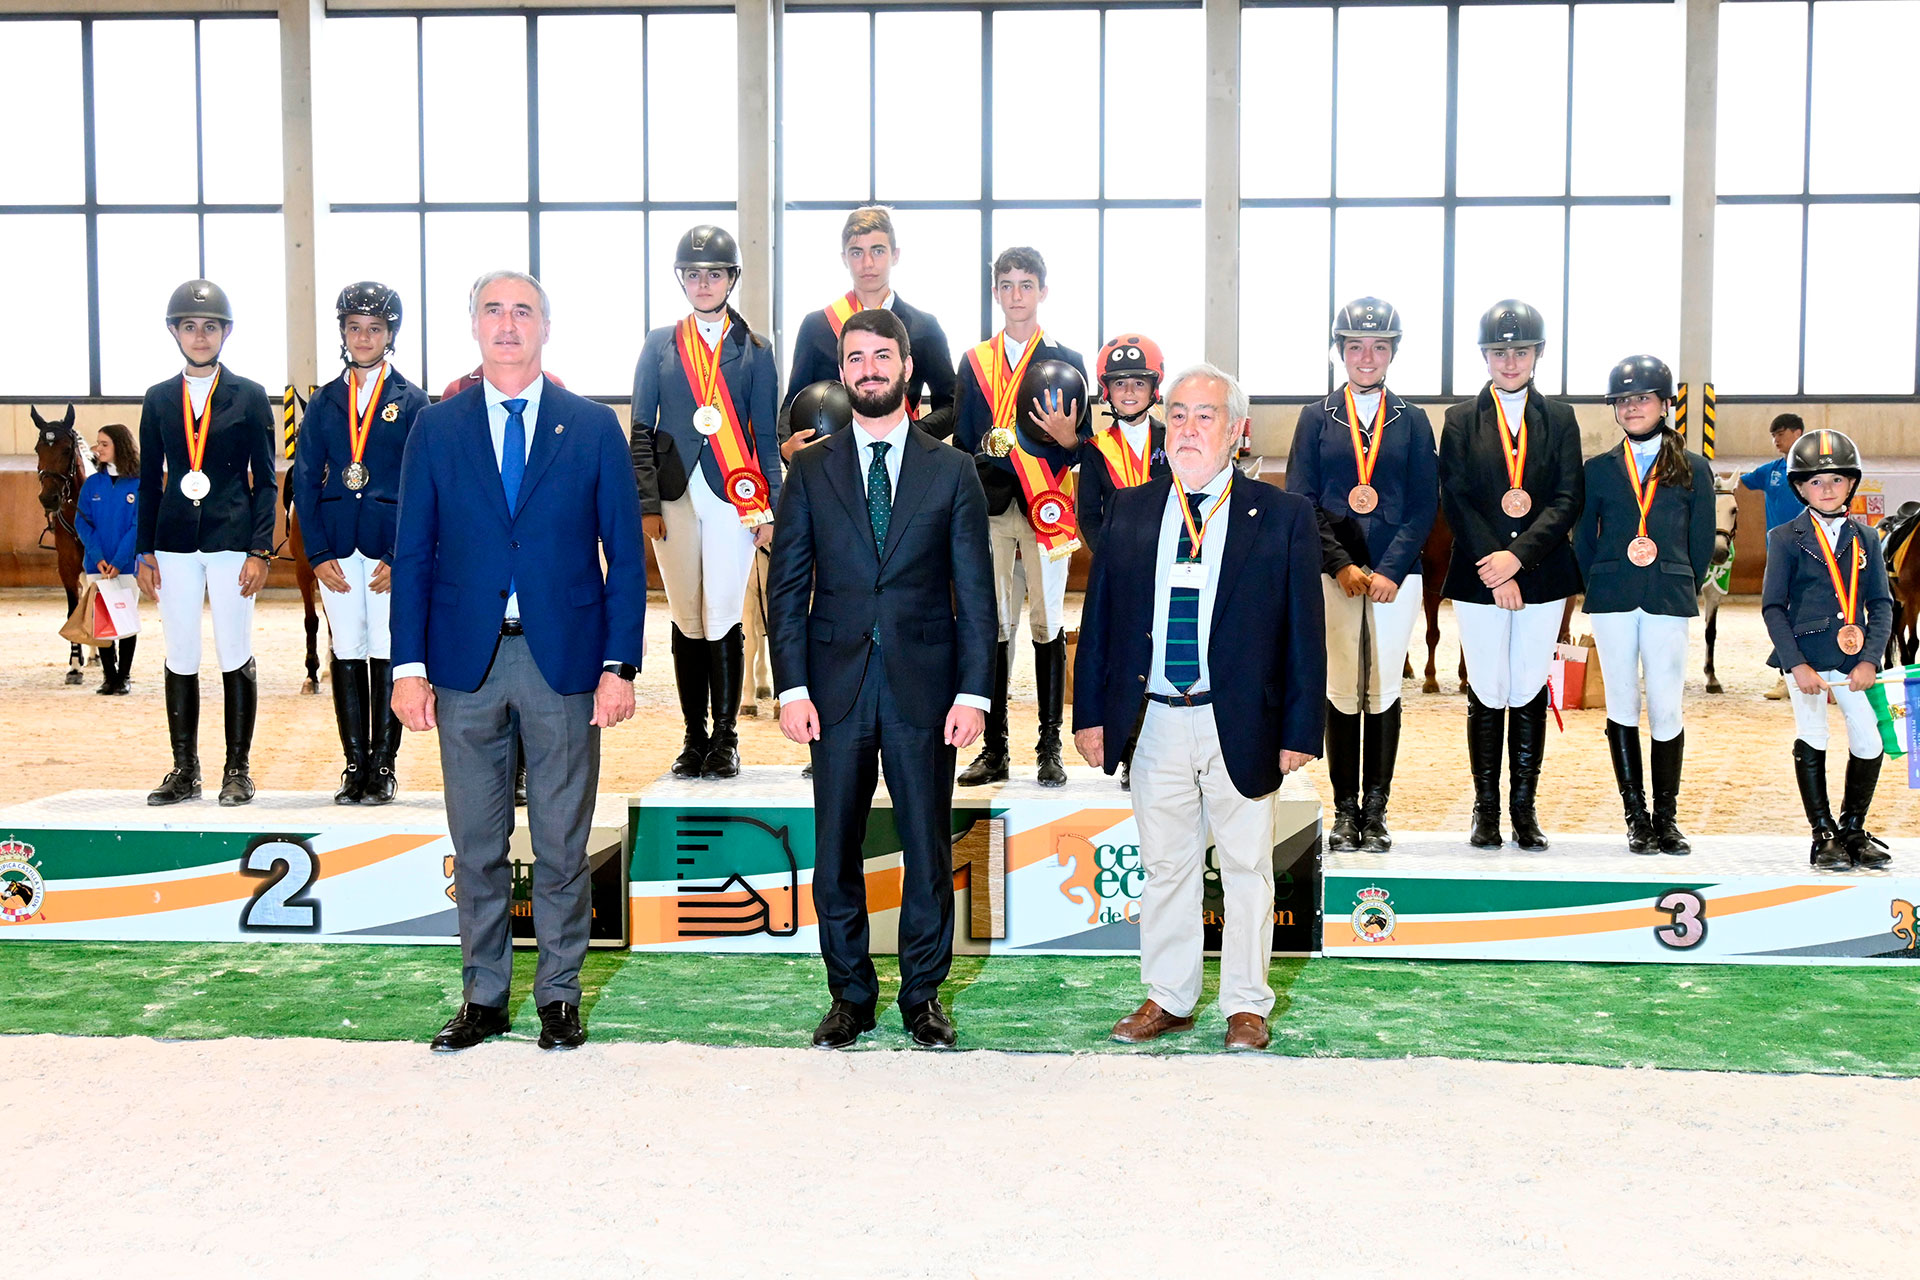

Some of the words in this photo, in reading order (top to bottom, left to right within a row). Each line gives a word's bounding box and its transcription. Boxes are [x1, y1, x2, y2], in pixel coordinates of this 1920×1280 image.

[243, 837, 318, 931] 2
[951, 817, 1006, 940] 1
[1100, 906, 1122, 924] de
[1656, 889, 1705, 949] 3
